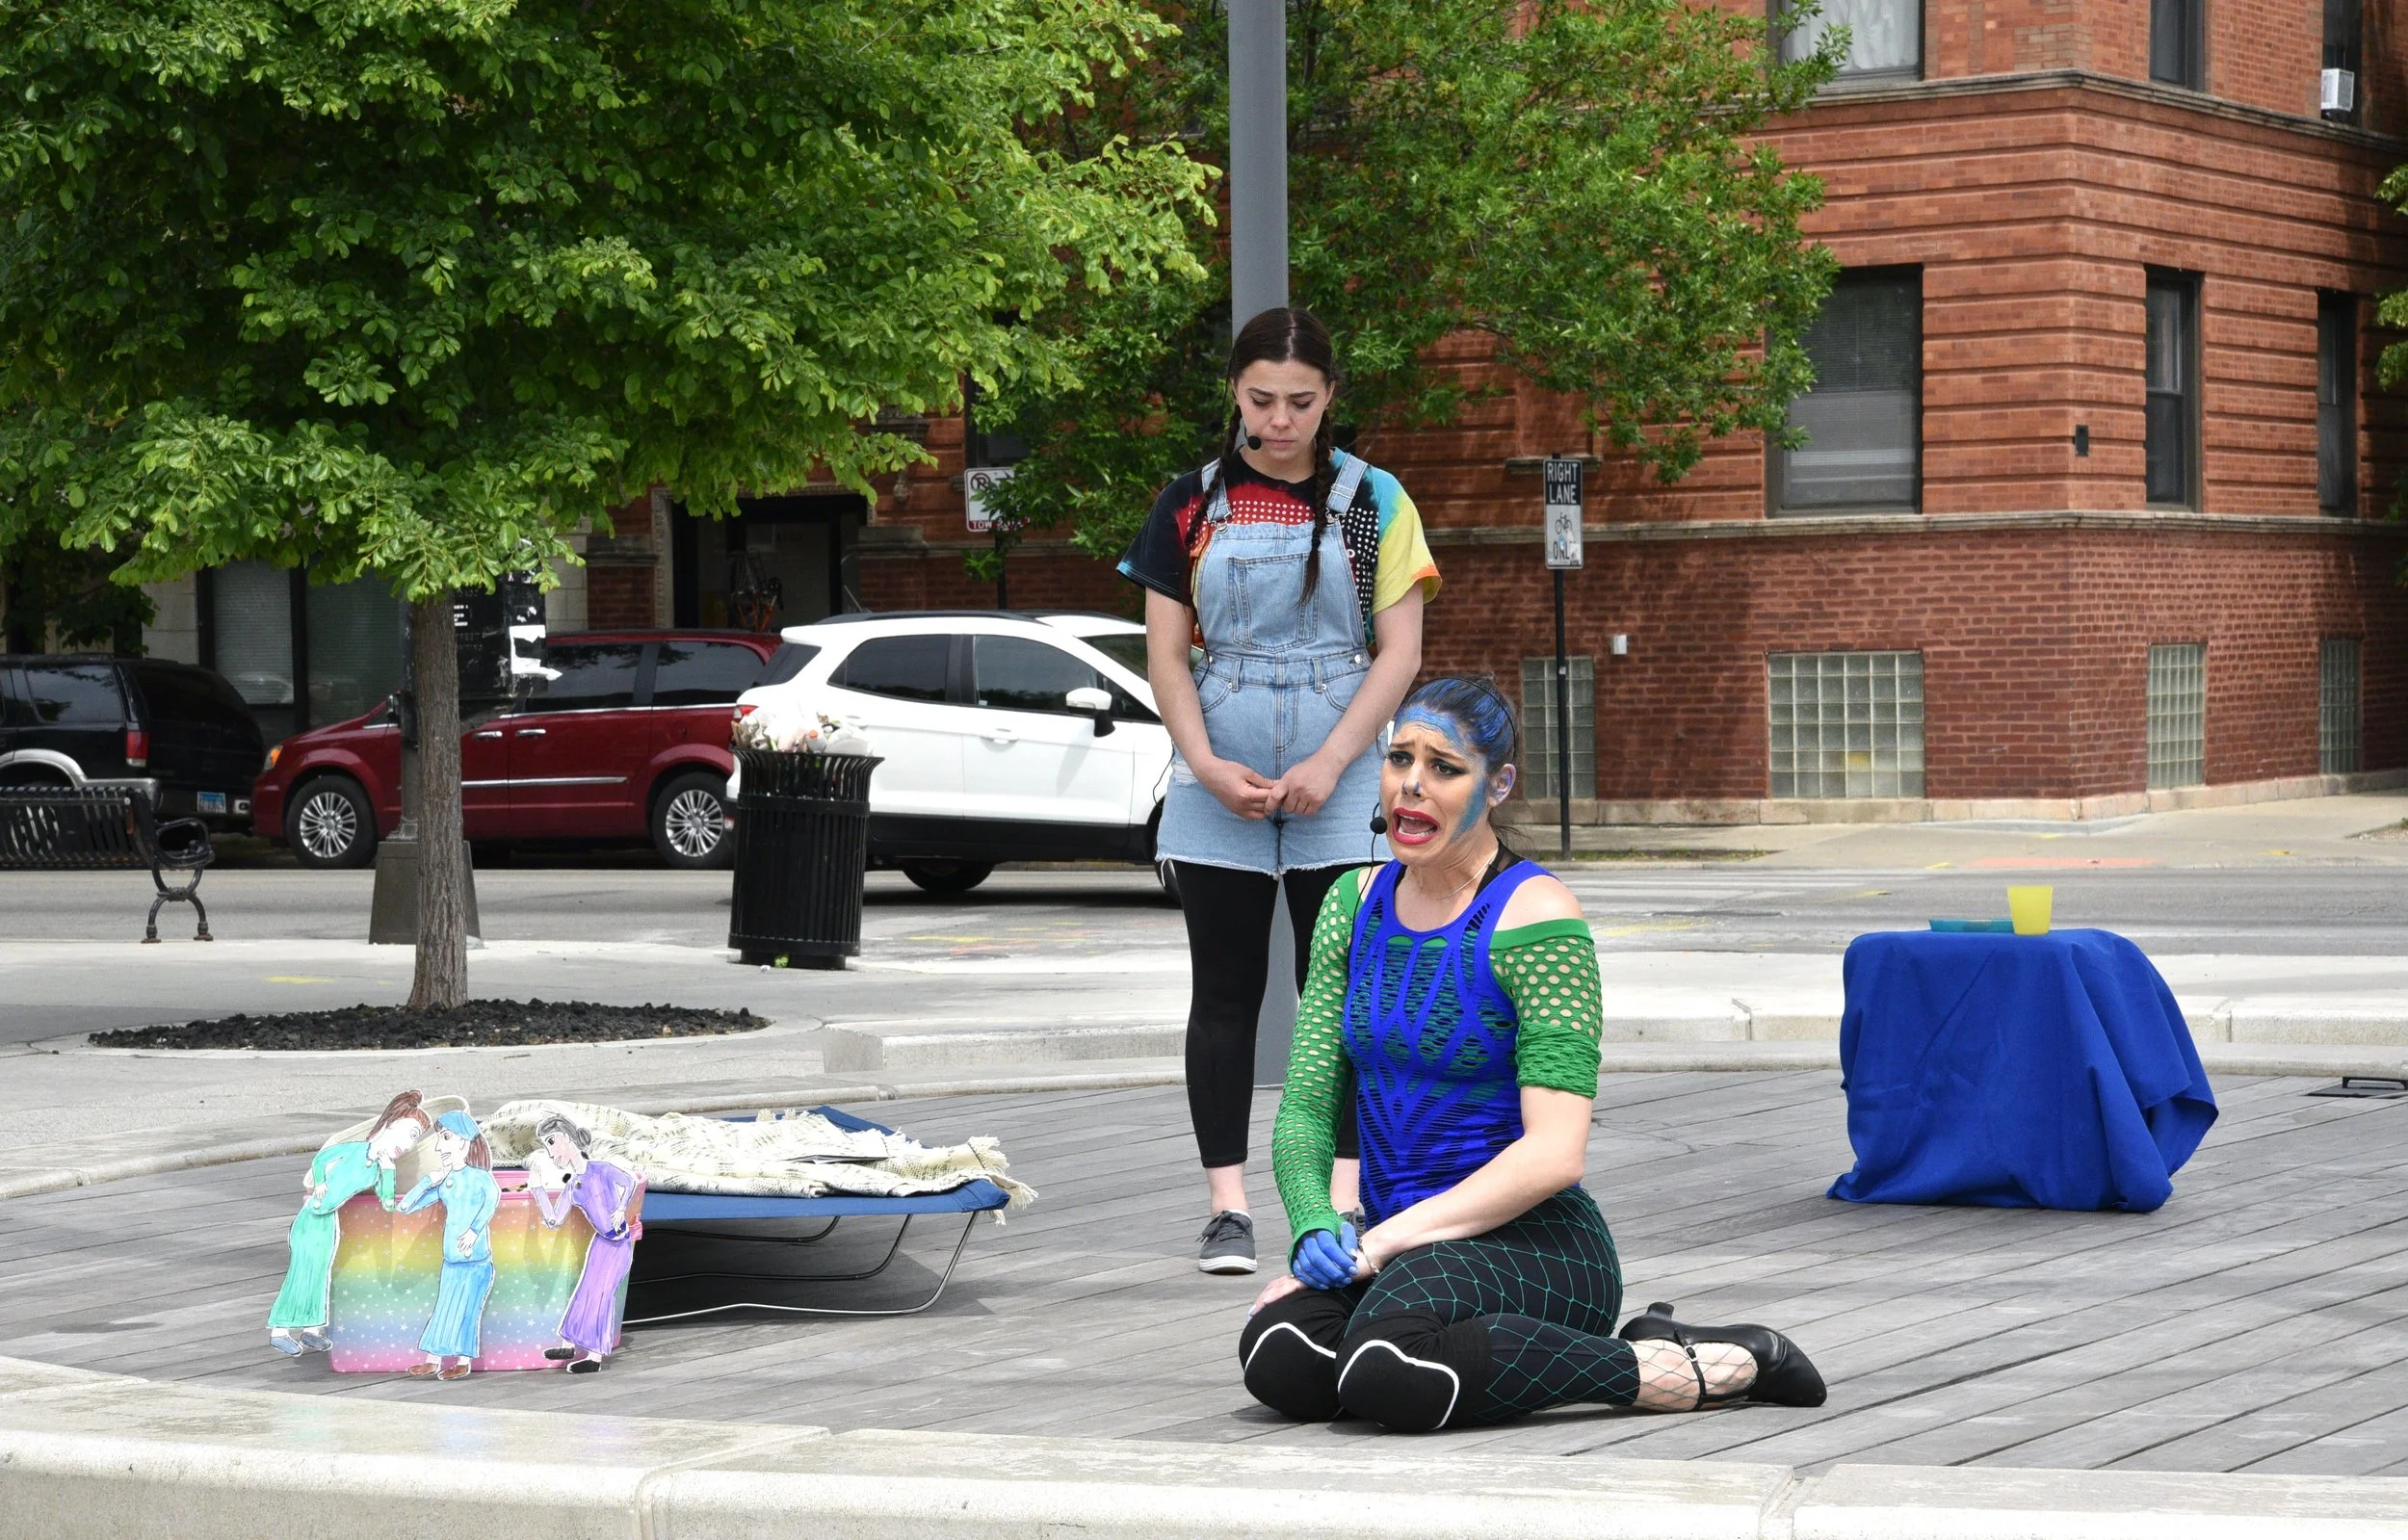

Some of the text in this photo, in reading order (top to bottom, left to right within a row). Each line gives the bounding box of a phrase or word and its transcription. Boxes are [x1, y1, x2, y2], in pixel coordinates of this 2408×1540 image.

[1547, 462, 1578, 482] RIGHT
[1549, 483, 1577, 503] LANE
[1553, 540, 1576, 560] ONL
